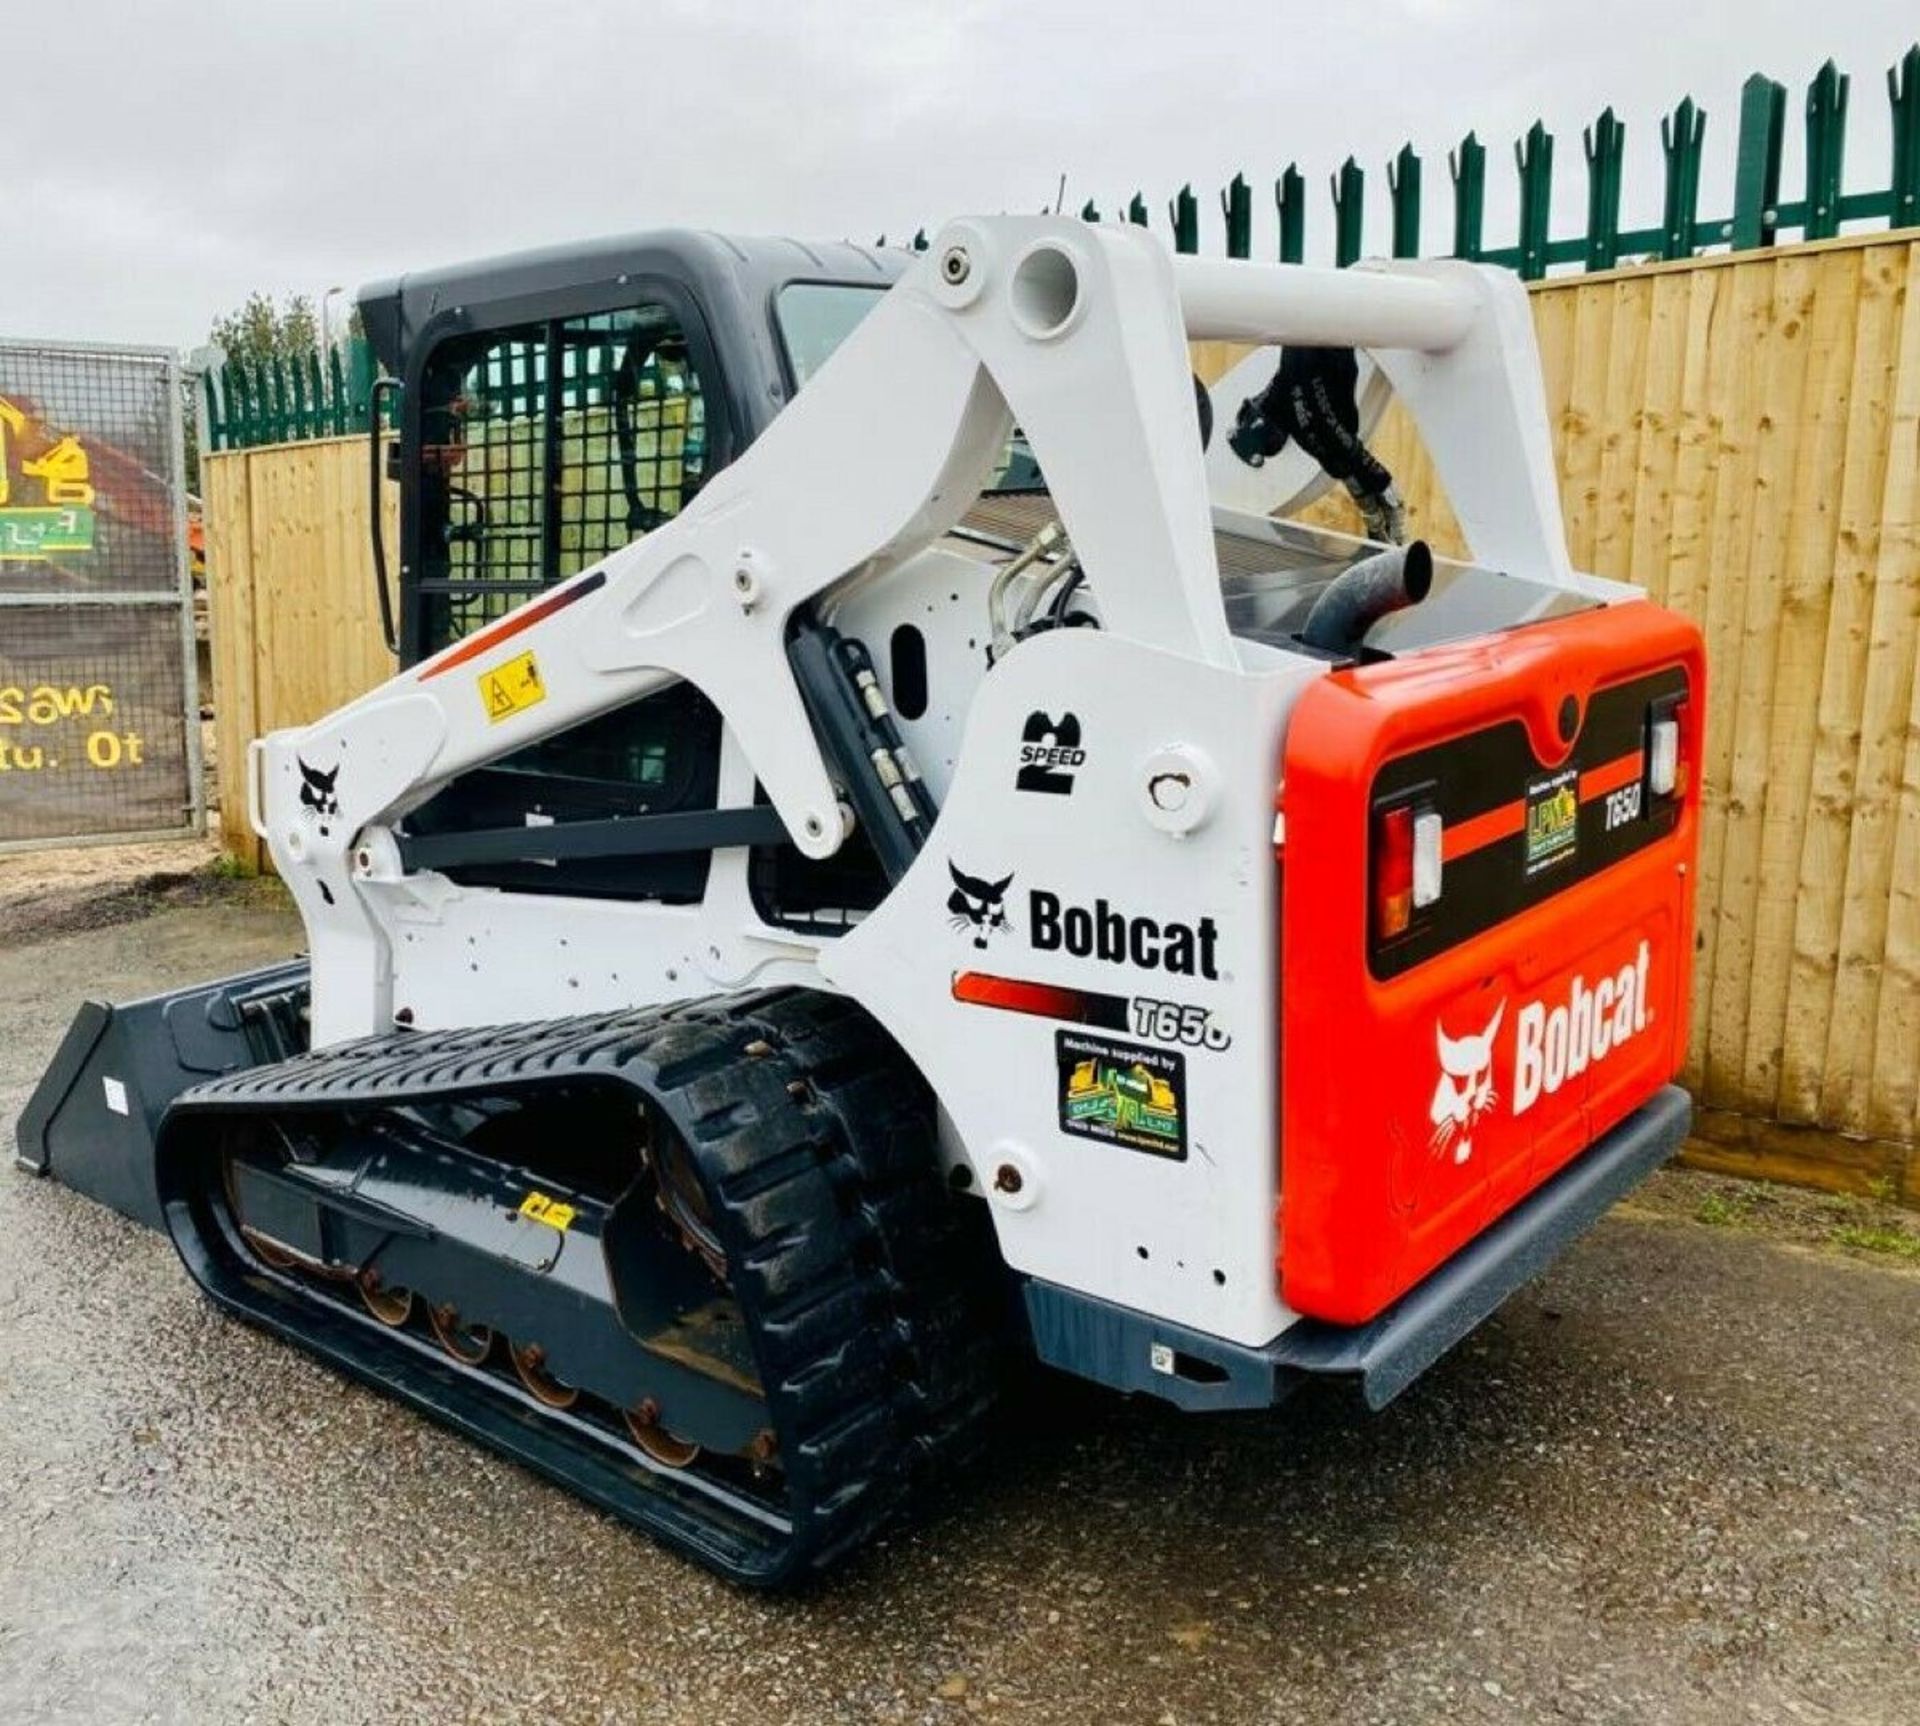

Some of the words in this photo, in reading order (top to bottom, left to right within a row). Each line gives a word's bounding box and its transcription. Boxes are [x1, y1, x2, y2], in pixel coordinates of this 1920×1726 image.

[1020, 746, 1086, 766] SPEED
[1605, 782, 1641, 831] T650
[1029, 889, 1219, 981] Bobcat
[1513, 939, 1650, 1117] Bobcat
